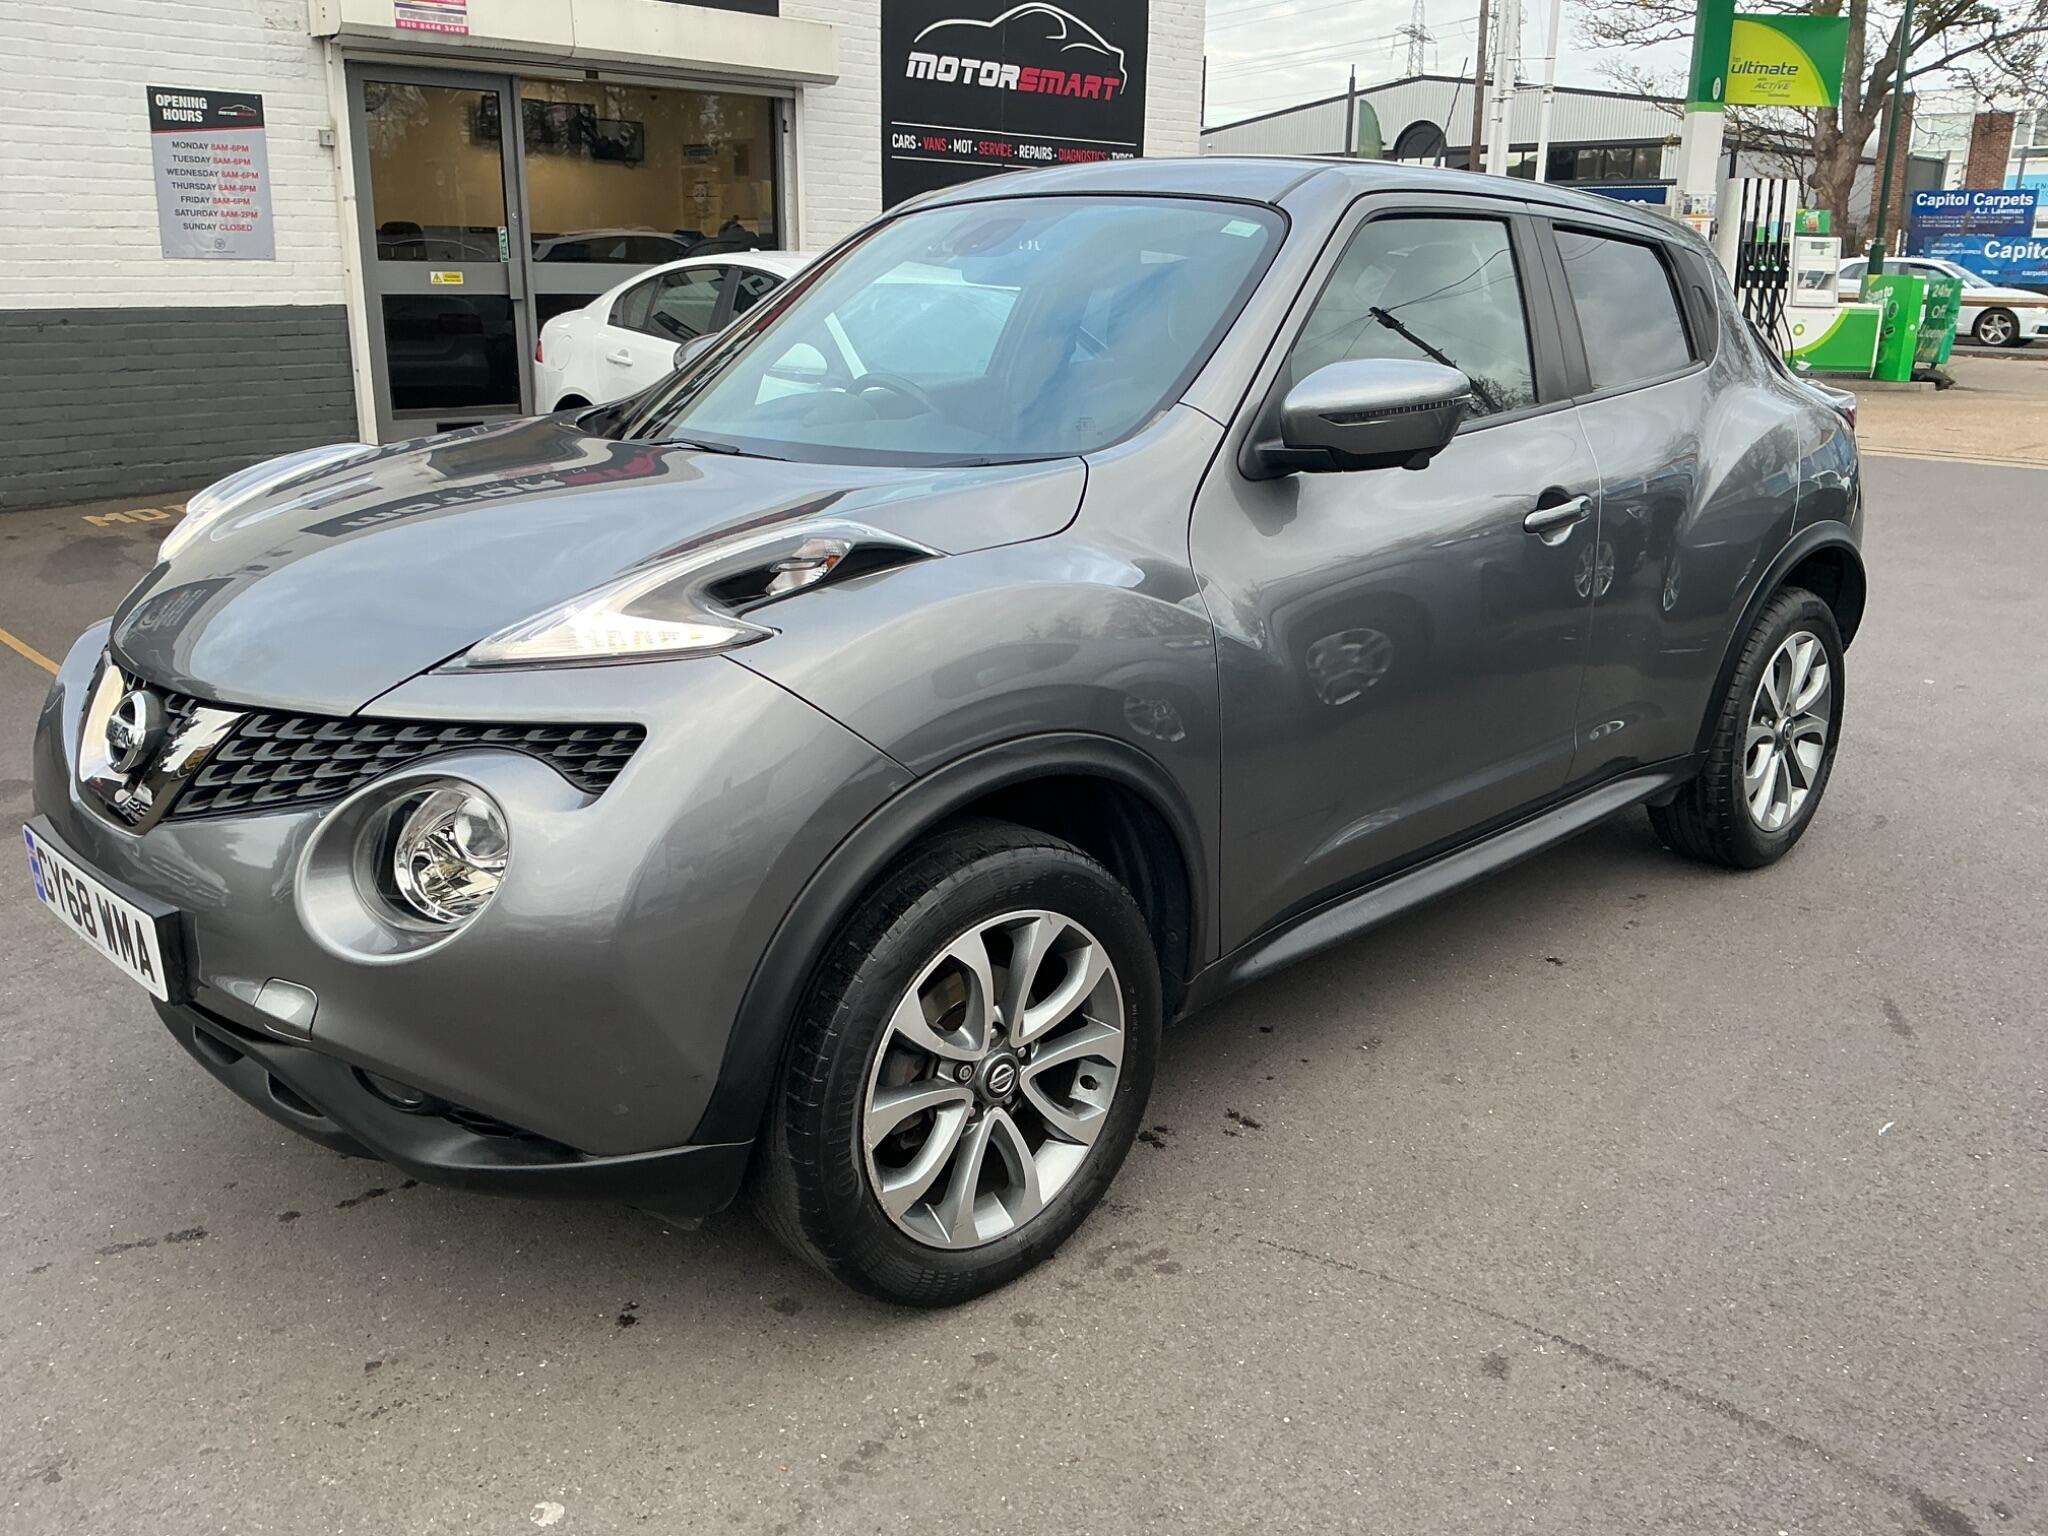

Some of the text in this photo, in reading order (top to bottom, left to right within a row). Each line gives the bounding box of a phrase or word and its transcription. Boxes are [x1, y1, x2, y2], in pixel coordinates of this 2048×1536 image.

[1731, 60, 1799, 76] ultimate
[905, 51, 1121, 102] MOTORSMART
[1754, 82, 1790, 90] ACTIVE
[155, 94, 208, 110] OPENING
[163, 109, 203, 122] HOURS
[172, 141, 208, 151] MONDAY
[892, 133, 917, 150] CARS
[922, 137, 948, 151] VANS
[953, 140, 974, 154] MOT
[978, 142, 1013, 157] SERVICE
[1018, 145, 1053, 160] REPAIRS
[1058, 149, 1107, 162] DIAGNOSTICS
[173, 154, 210, 164] TUESDAY
[166, 168, 219, 178] WEDNESDAY
[172, 181, 216, 191] THURSDAY
[180, 195, 210, 204] FRIDAY
[1916, 193, 1969, 209] Capitol
[1973, 193, 2034, 209] Carpets
[174, 208, 218, 218] SATURDAY
[183, 222, 253, 232] SUNDAY CLOSED
[36, 846, 157, 984] GY68 WMA
